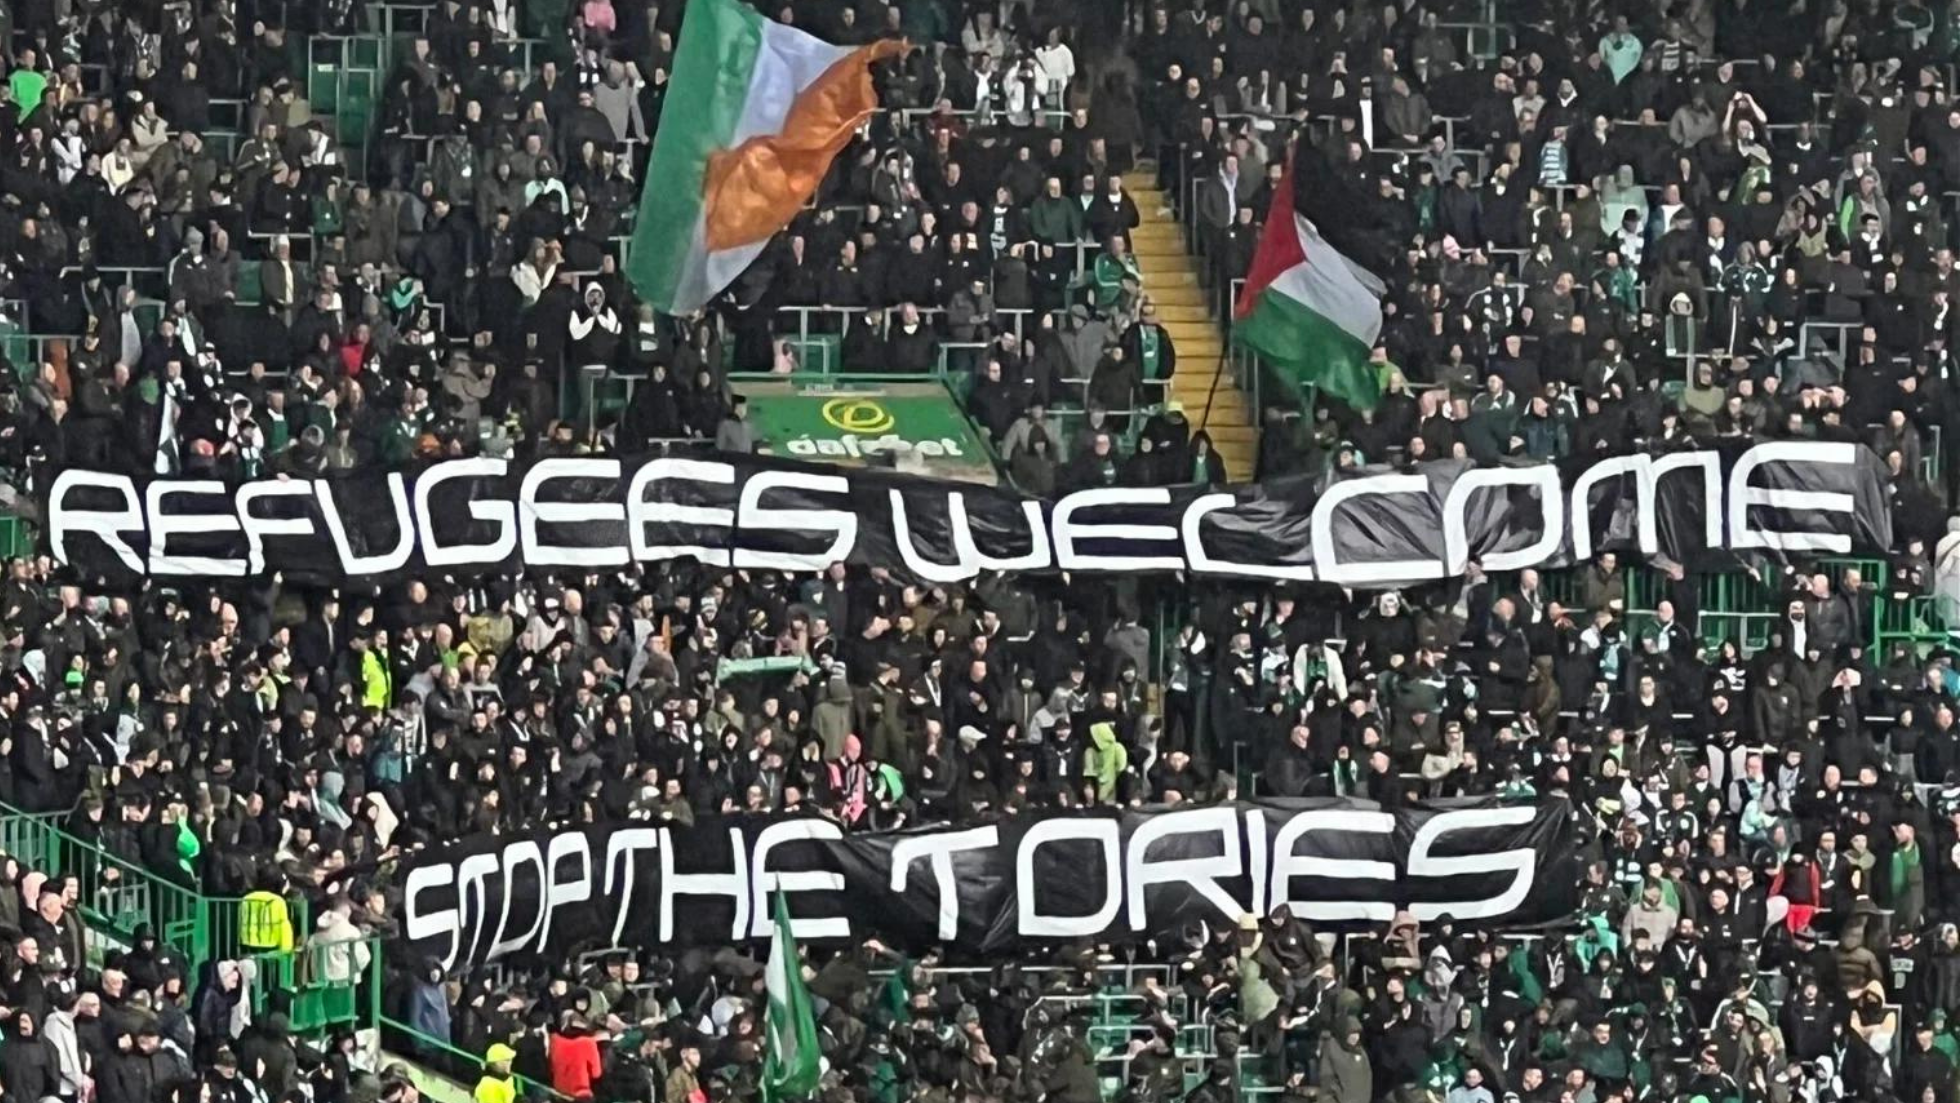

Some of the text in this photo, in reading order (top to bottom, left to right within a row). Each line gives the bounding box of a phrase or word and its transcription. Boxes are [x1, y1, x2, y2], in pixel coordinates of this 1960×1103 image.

[48, 438, 1856, 584] REFUGEES WELCOME
[405, 806, 1537, 974] STOP THE TORIES
